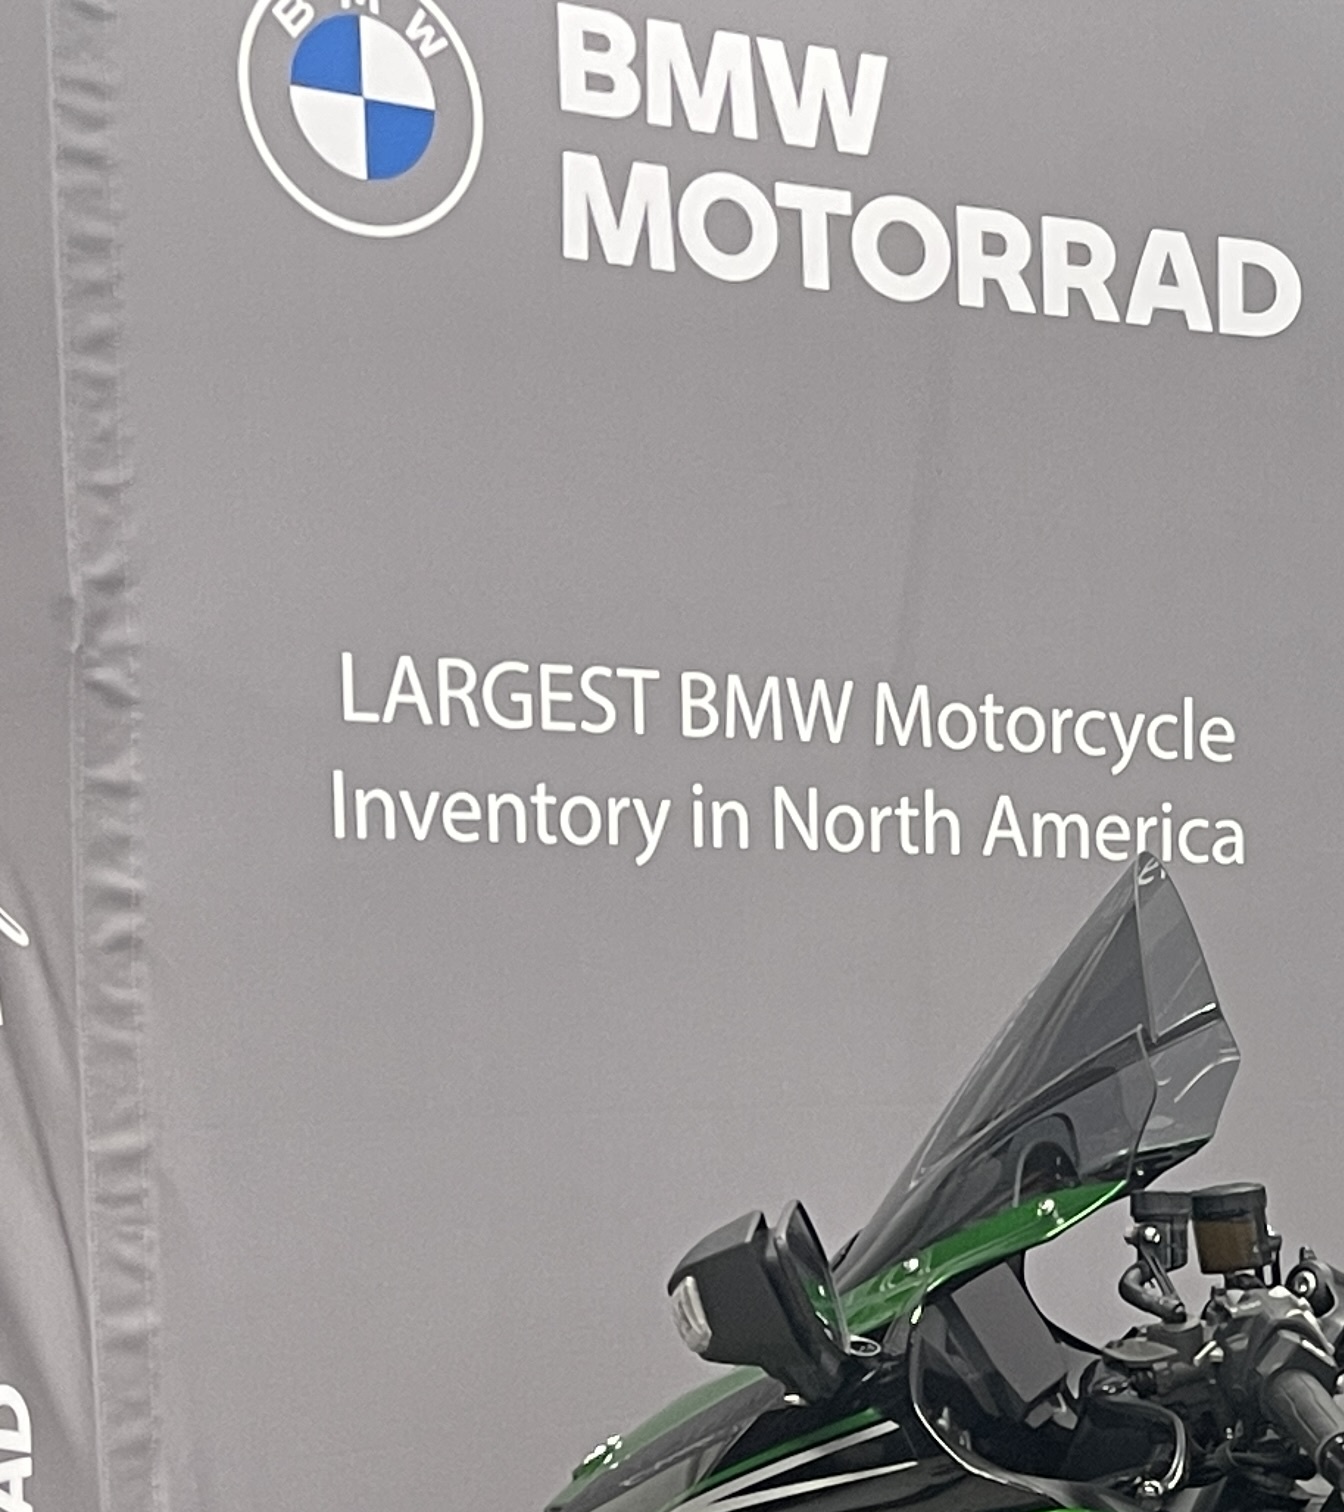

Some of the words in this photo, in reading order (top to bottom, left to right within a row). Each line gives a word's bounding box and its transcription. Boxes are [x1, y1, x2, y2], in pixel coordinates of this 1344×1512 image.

[556, 1, 889, 156] BMW
[562, 150, 1302, 337] MOTORRAD
[341, 651, 660, 735] LARGEST
[680, 671, 854, 744] BMW
[875, 681, 1236, 776] Motorcycle
[332, 769, 671, 867] Inventory
[692, 783, 749, 850] in
[774, 785, 961, 856] North
[982, 794, 1244, 865] America
